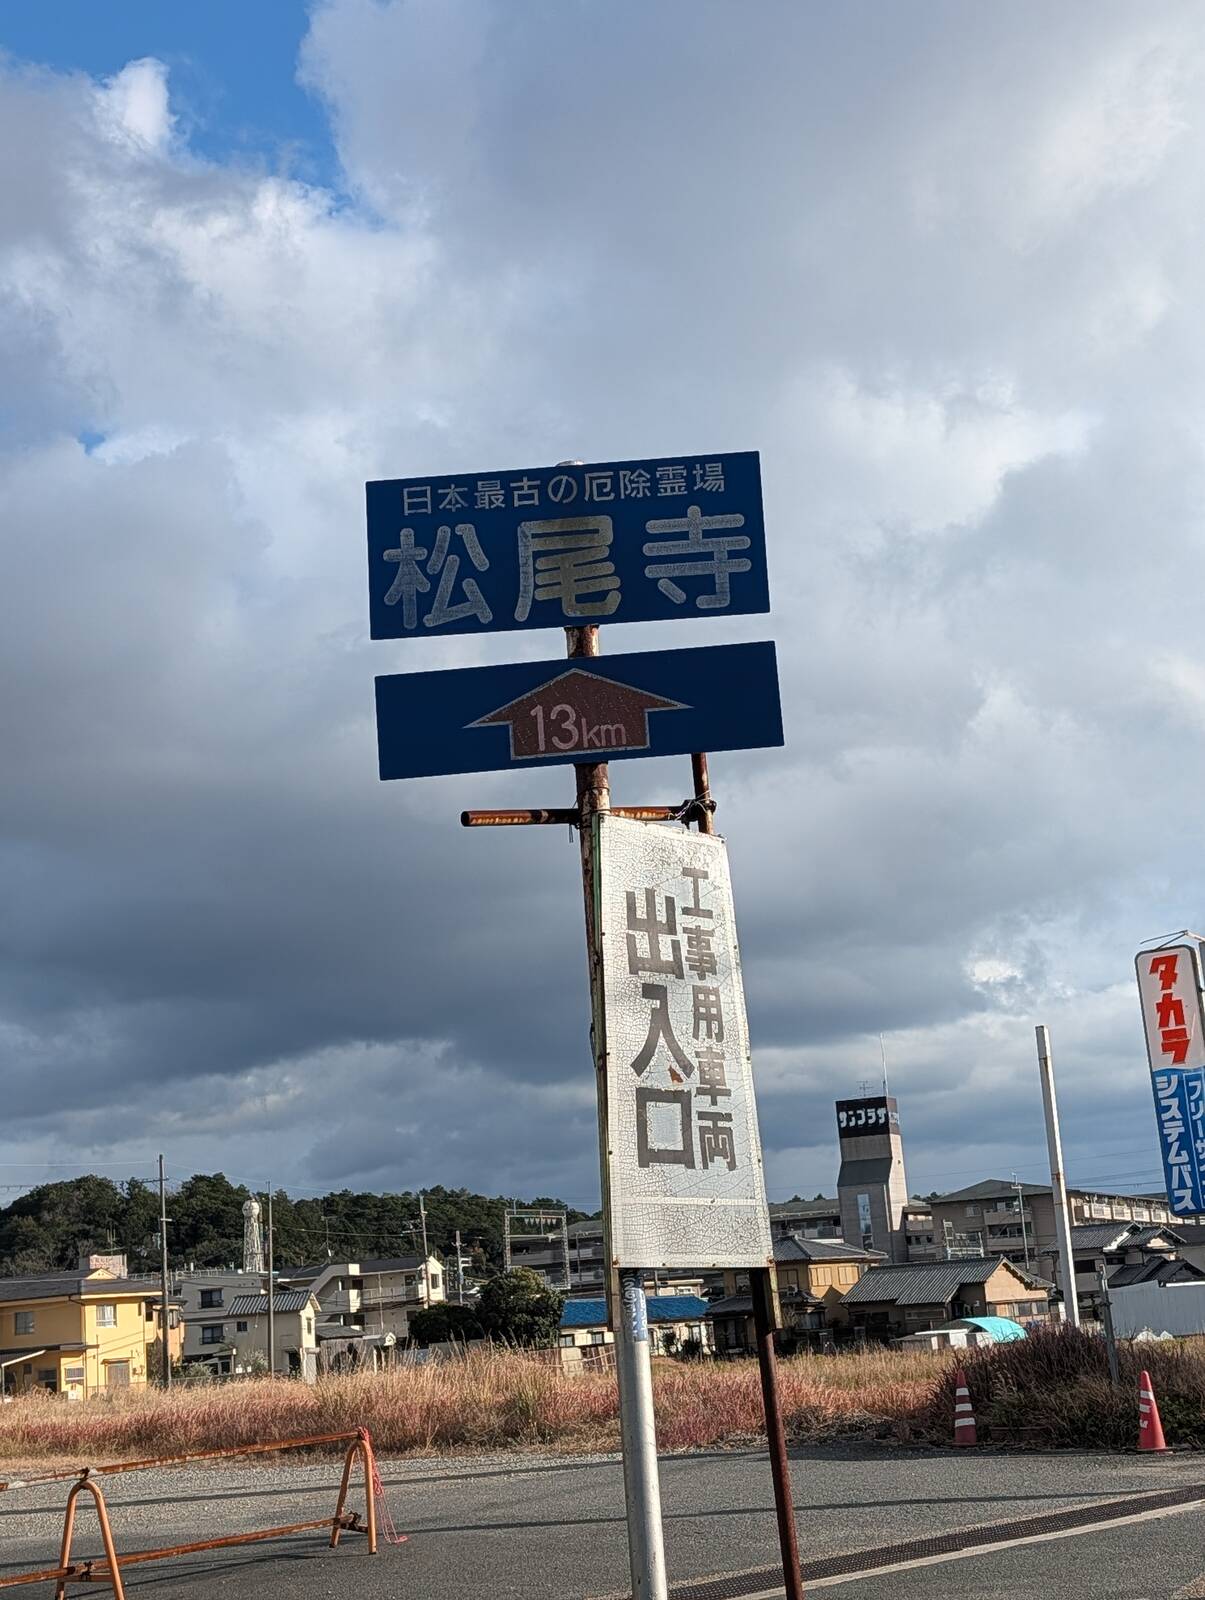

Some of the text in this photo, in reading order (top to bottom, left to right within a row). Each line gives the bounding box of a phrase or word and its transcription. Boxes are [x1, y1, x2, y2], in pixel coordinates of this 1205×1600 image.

[403, 462, 725, 516] 日本最古の厄除霊場
[383, 505, 751, 629] 松尾寺
[530, 704, 626, 751] 13km
[625, 887, 696, 1169] 出入口
[681, 867, 736, 1171] 工事用車両
[1149, 954, 1191, 1065] タカラ
[838, 1107, 887, 1128] サンプラザ
[1155, 1074, 1196, 1211] システムバス
[1188, 1080, 1205, 1200] フリーサ
